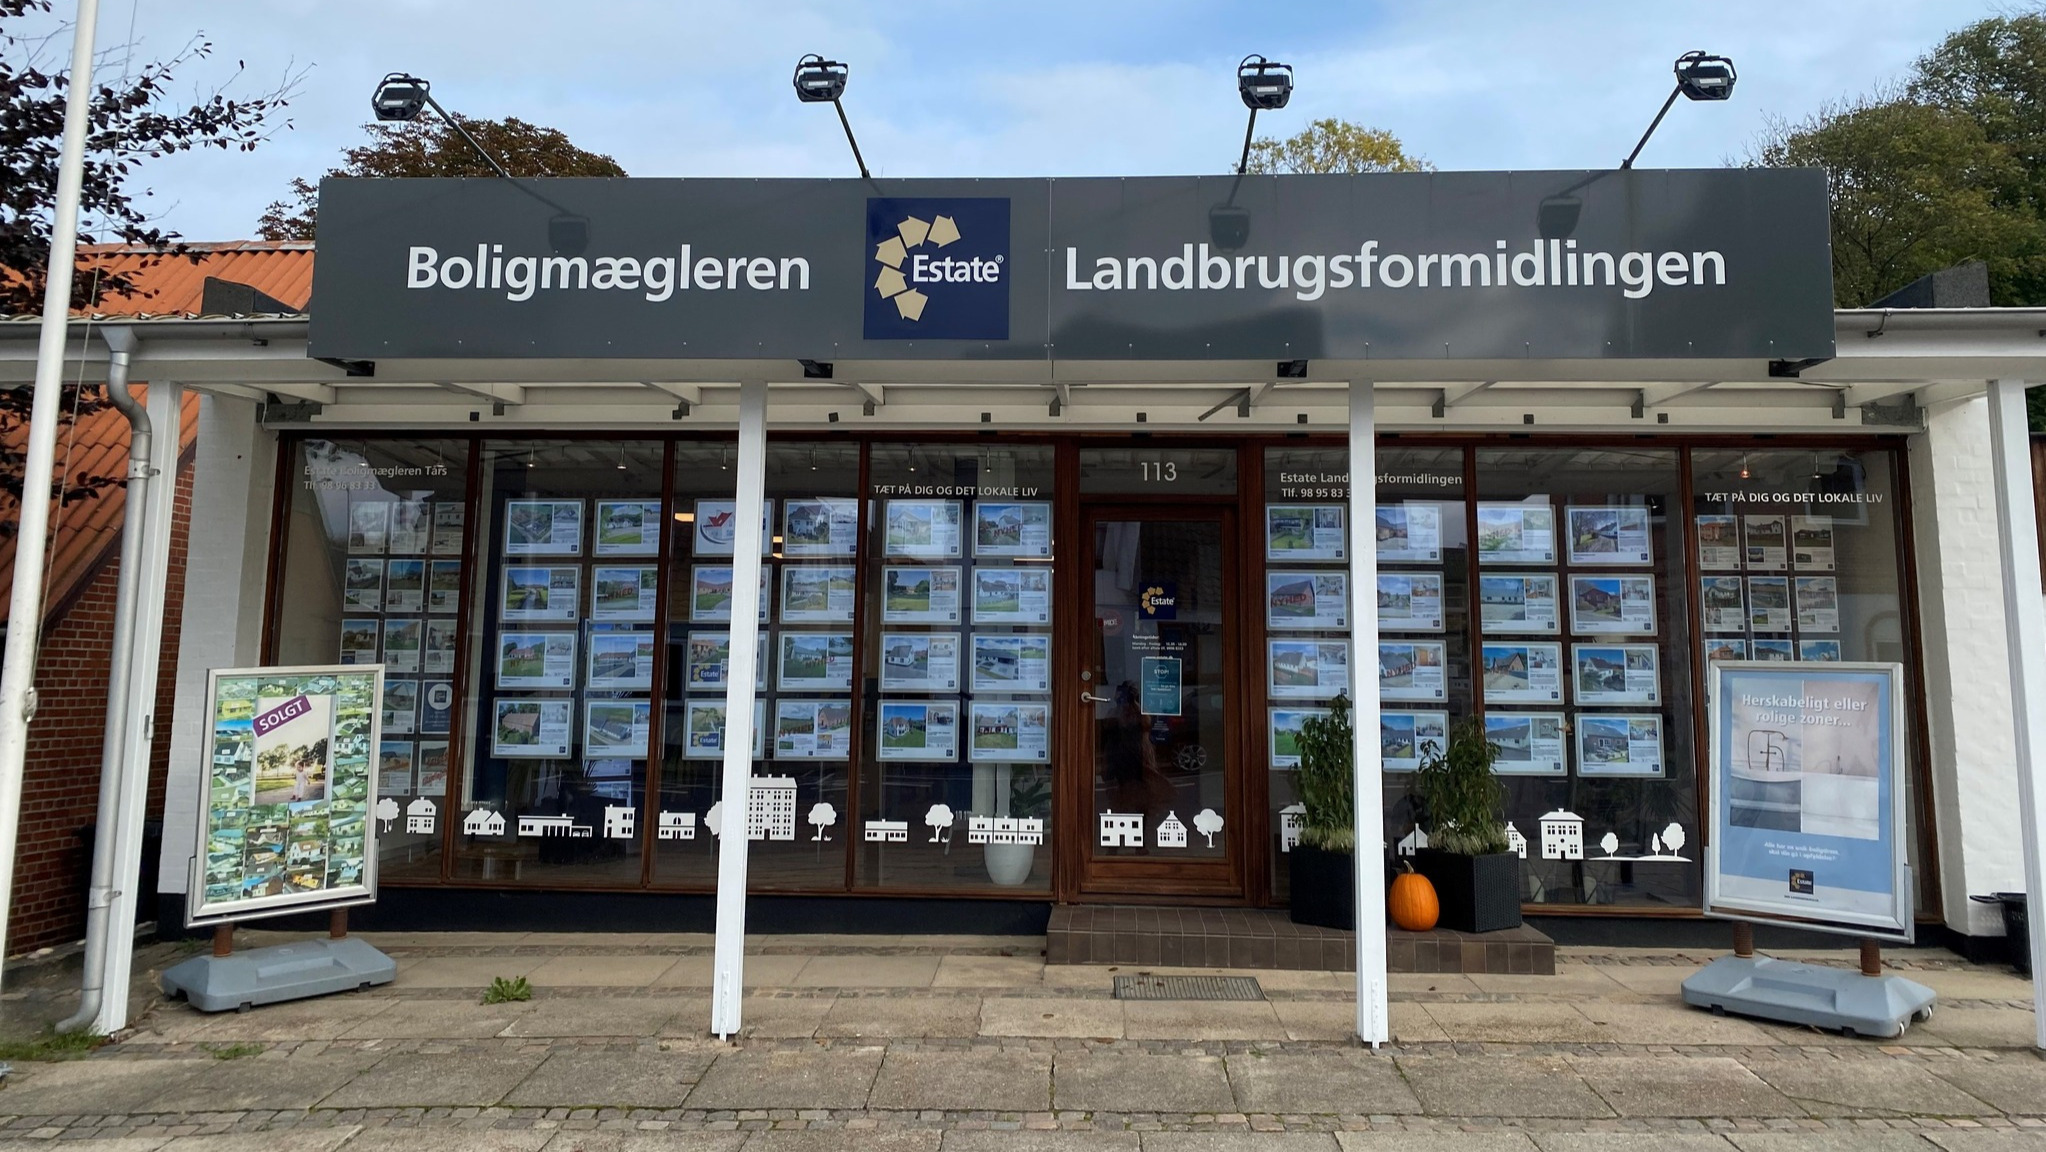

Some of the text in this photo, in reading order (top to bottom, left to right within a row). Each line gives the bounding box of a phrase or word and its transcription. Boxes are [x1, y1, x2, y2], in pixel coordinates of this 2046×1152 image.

[406, 243, 810, 302] Boligmægleren
[1065, 239, 1727, 300] Landbrugsformidlingen
[304, 465, 337, 476] Estate
[340, 465, 422, 478] Boligmægleren
[1141, 462, 1177, 481] 113
[1280, 472, 1317, 483] Estate
[874, 483, 1038, 497] TÆT PÅ DIG OG DET LOKALE LIV
[1281, 488, 1298, 498] Tlf.
[1300, 488, 1313, 498] 98
[1316, 488, 1328, 498] 95
[1331, 488, 1343, 498] 83
[1705, 490, 1883, 503] TÆT PÅ DIG OG DET LOKALE LIV
[1742, 694, 1868, 711] Herskabeligt eller
[259, 699, 303, 731] SOLGT
[1756, 710, 1851, 727] rolige zoner...
